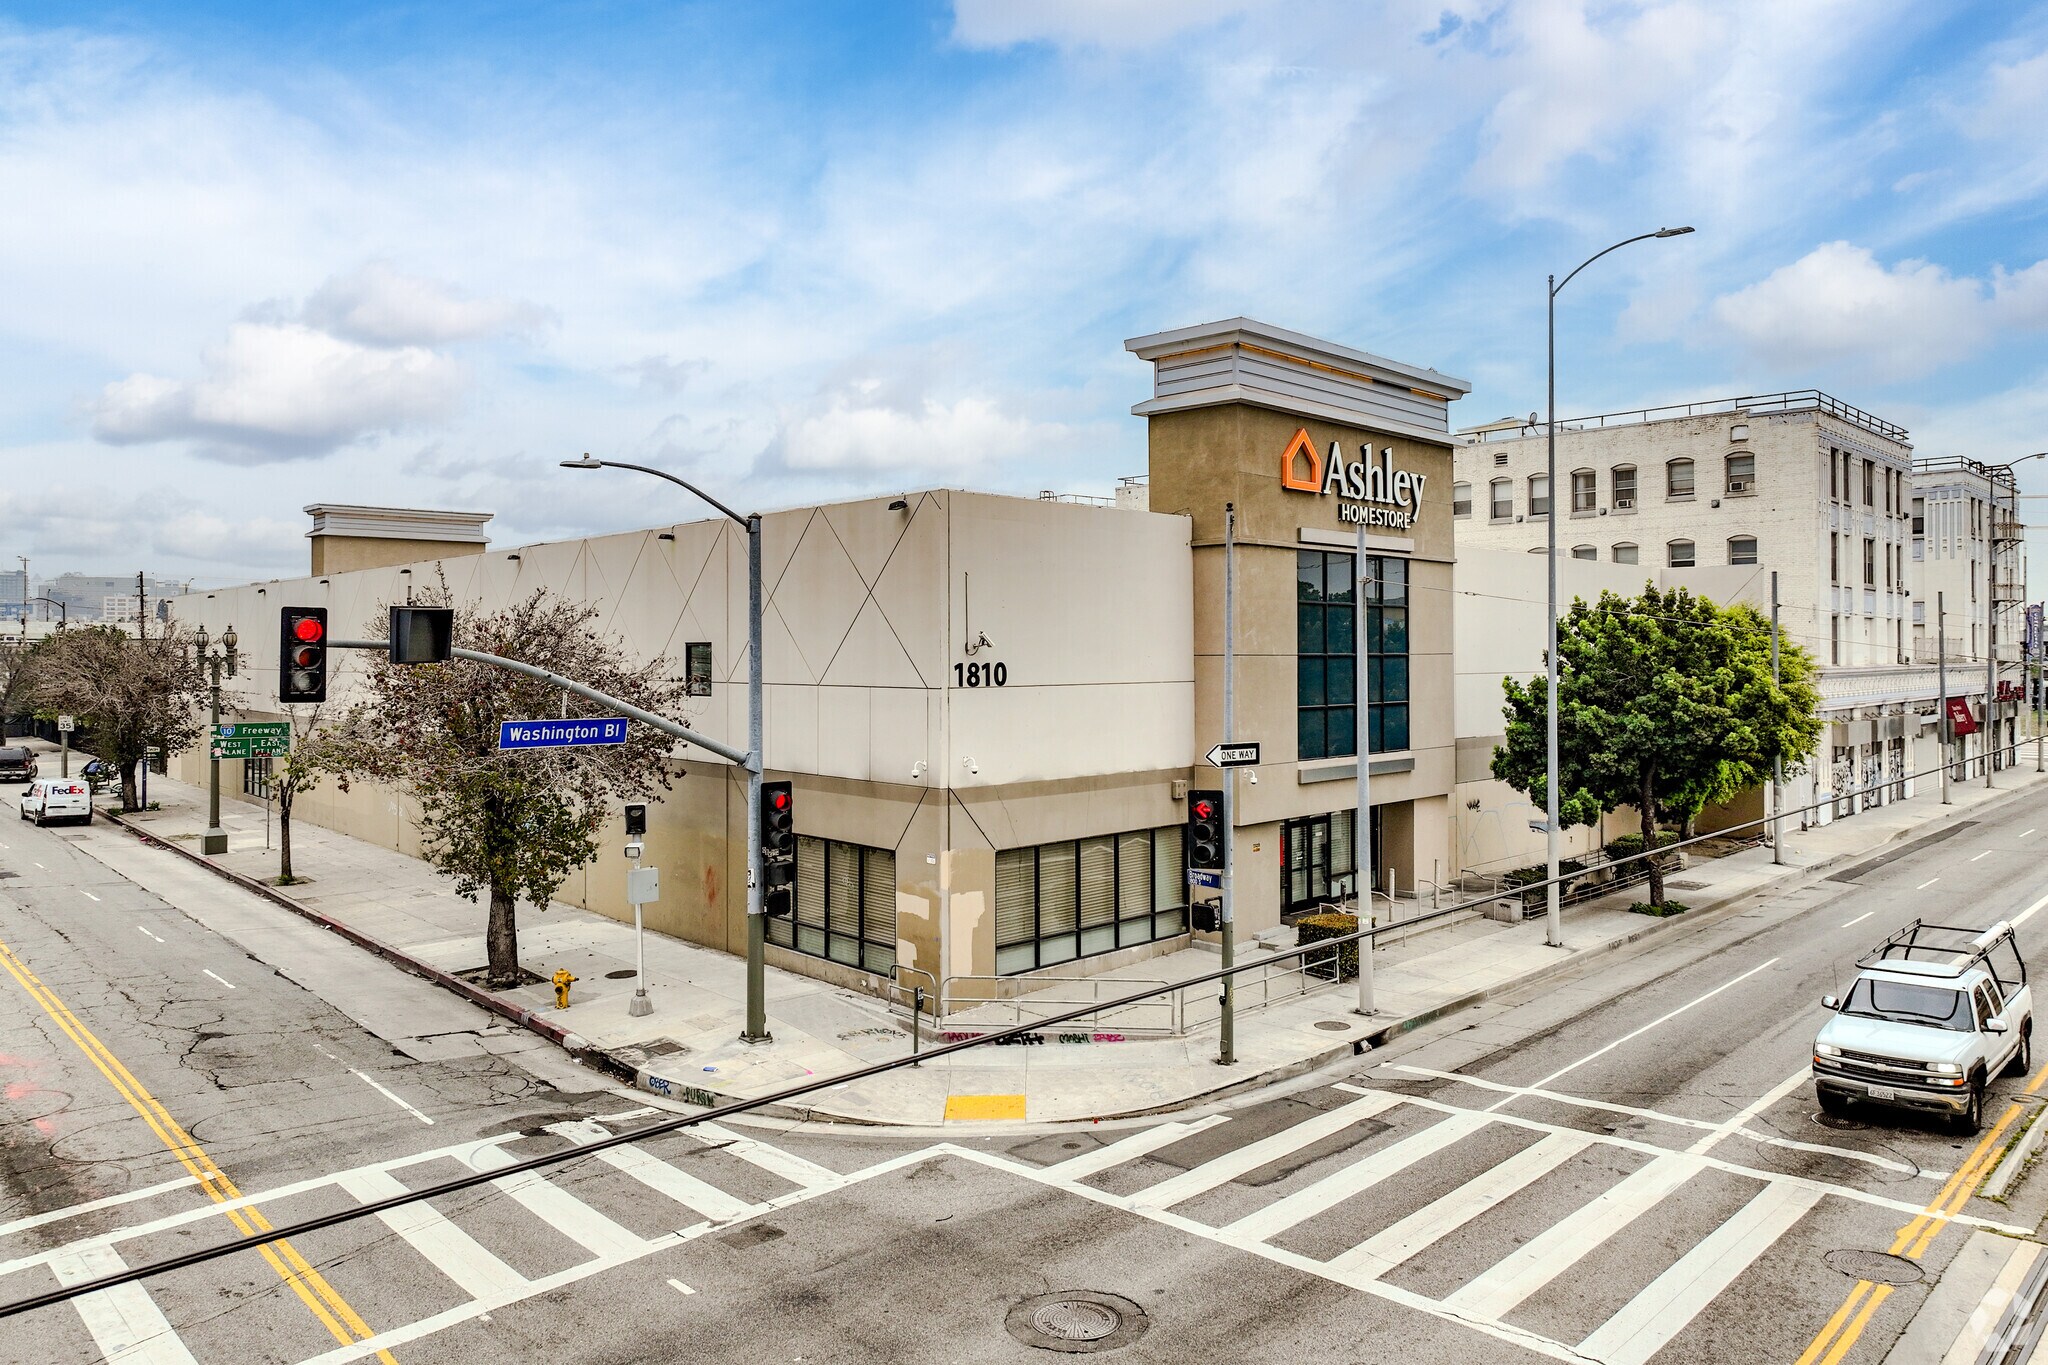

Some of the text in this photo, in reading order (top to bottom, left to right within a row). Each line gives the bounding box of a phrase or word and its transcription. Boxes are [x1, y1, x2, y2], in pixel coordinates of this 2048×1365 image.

[1322, 441, 1426, 523] Ashley
[1339, 503, 1411, 529] HOMESTORE
[954, 661, 1007, 688] 1810
[60, 722, 72, 730] 35
[242, 726, 282, 736] Freeway
[510, 723, 620, 743] Washington Bl
[220, 740, 242, 748] WEST
[227, 748, 247, 756] LANE
[1221, 749, 1255, 760] ONE WAY
[52, 785, 85, 795] FedEx
[1189, 870, 1213, 884] Broadway
